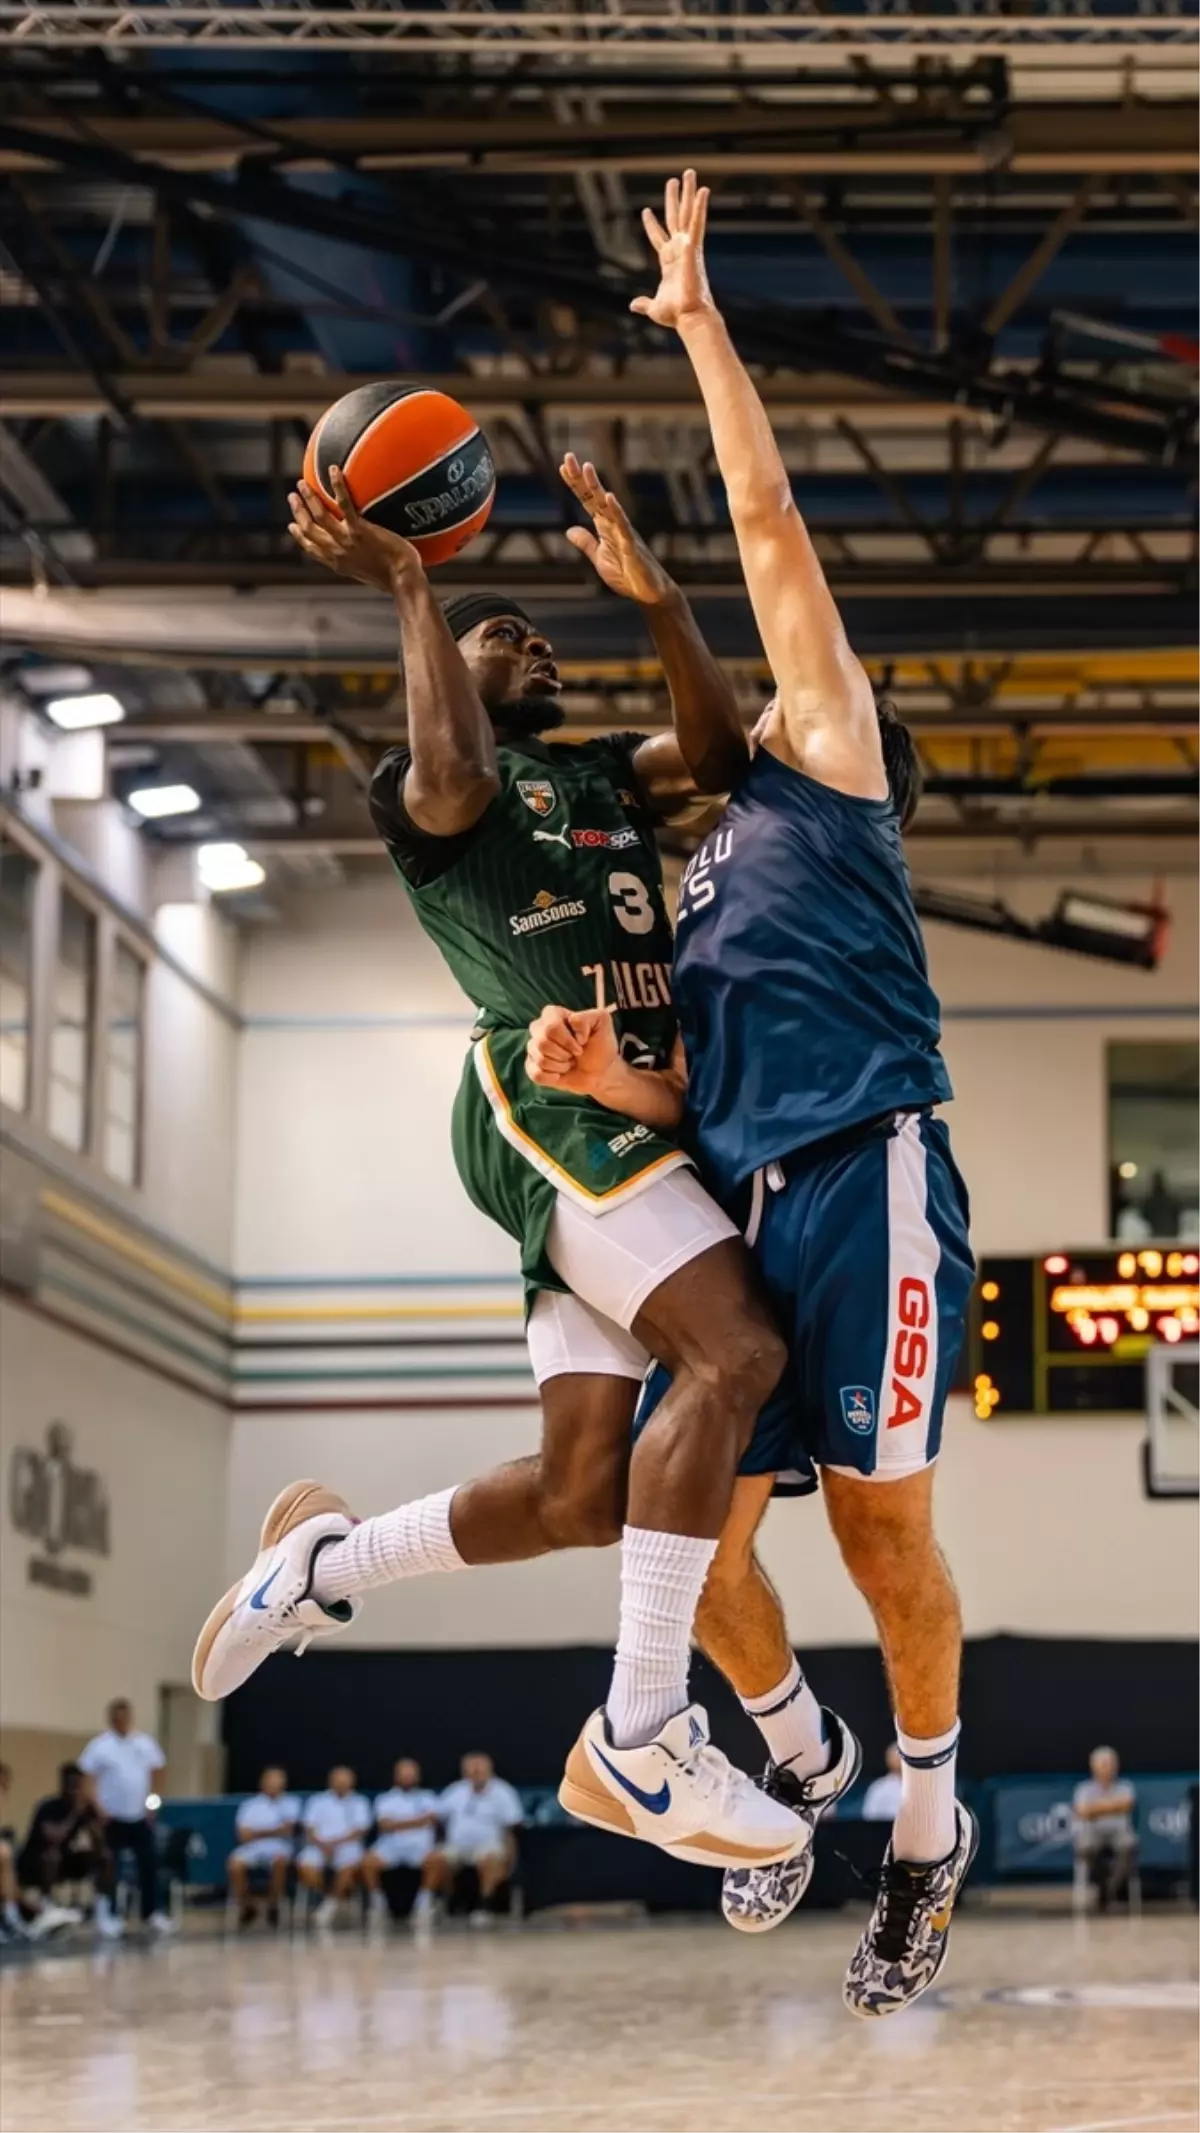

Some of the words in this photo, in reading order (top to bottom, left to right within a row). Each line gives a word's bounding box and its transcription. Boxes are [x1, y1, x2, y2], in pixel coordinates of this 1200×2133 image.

[509, 900, 587, 936] Samsonas
[608, 871, 656, 935] 3
[580, 960, 673, 1010] ZALGI
[887, 1277, 930, 1430] GSA
